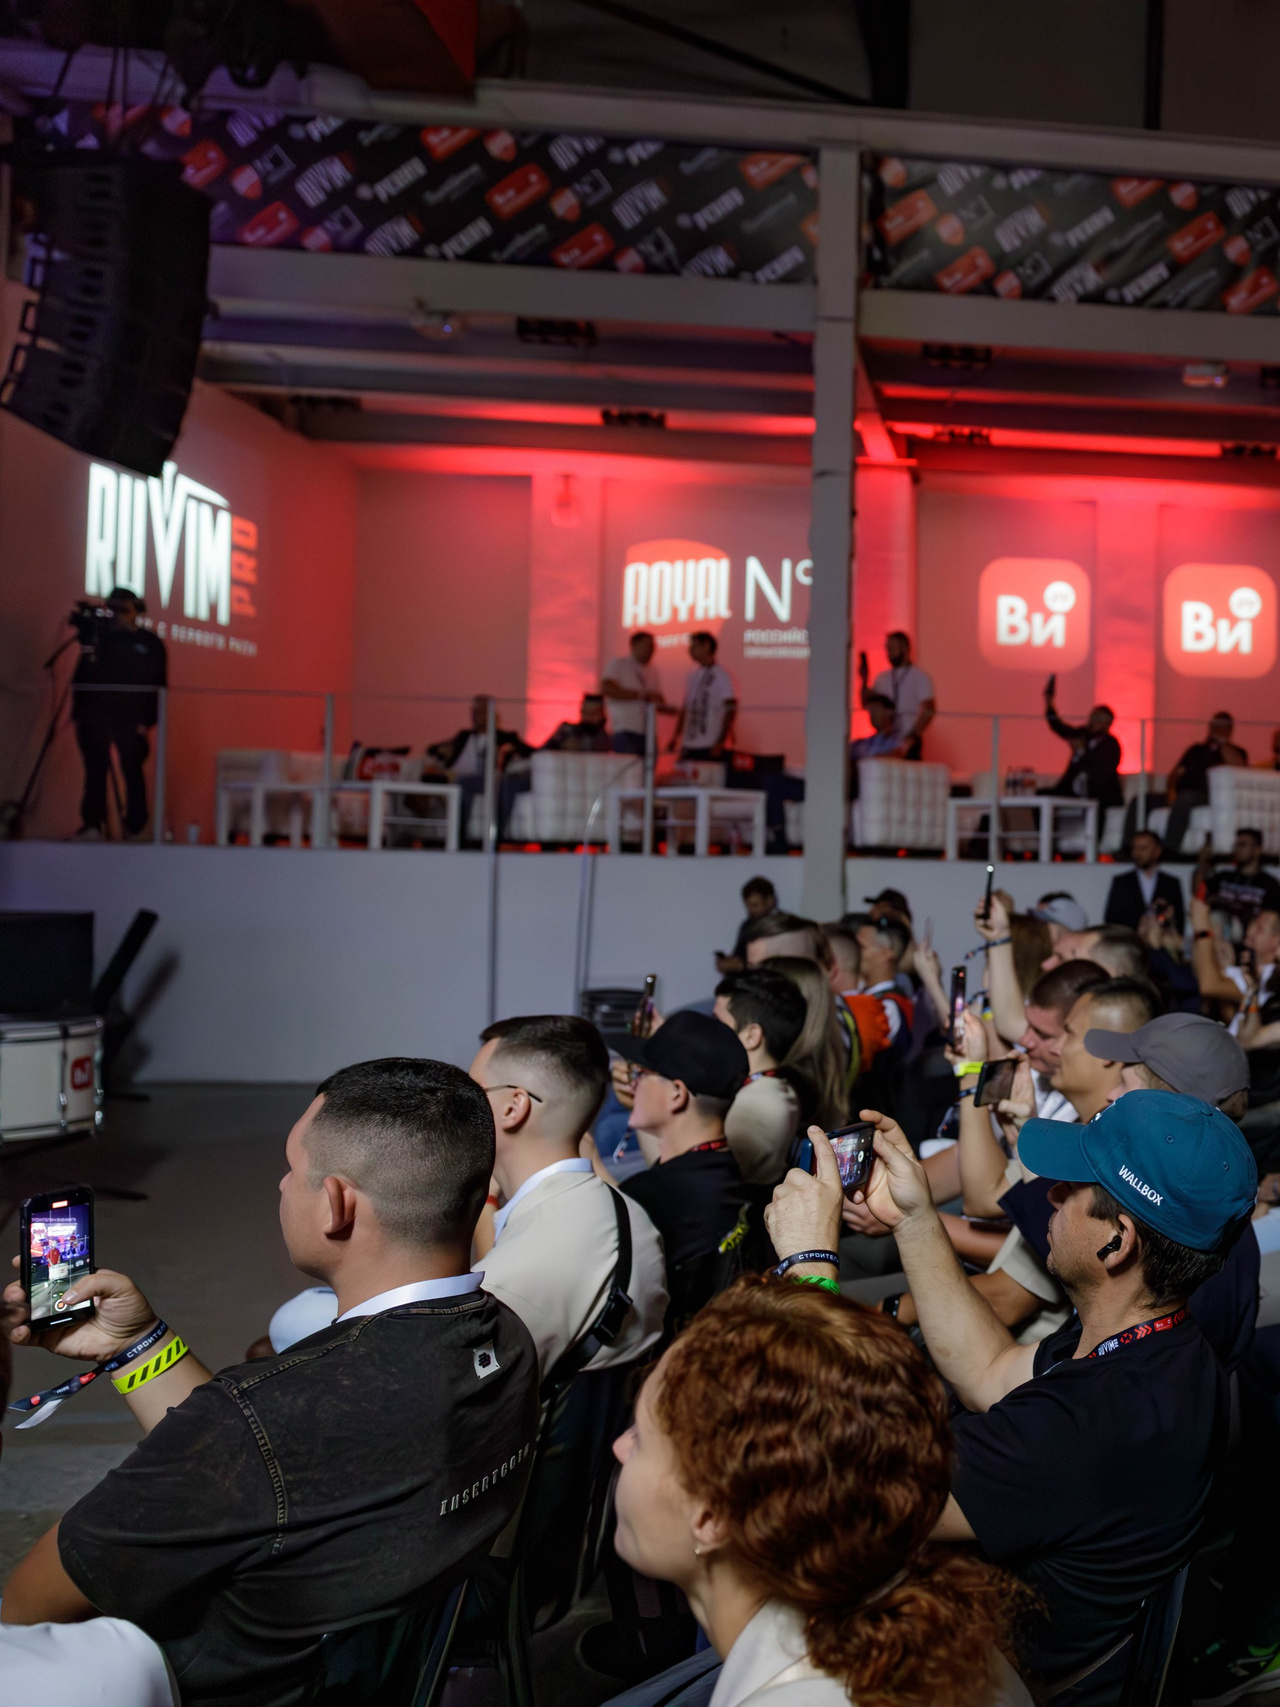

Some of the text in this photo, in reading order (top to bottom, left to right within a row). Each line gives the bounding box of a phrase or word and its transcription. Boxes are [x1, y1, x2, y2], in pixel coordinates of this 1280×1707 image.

[85, 460, 232, 627] RUVIM
[231, 514, 259, 618] PRO
[1118, 1164, 1164, 1207] WALLBOX
